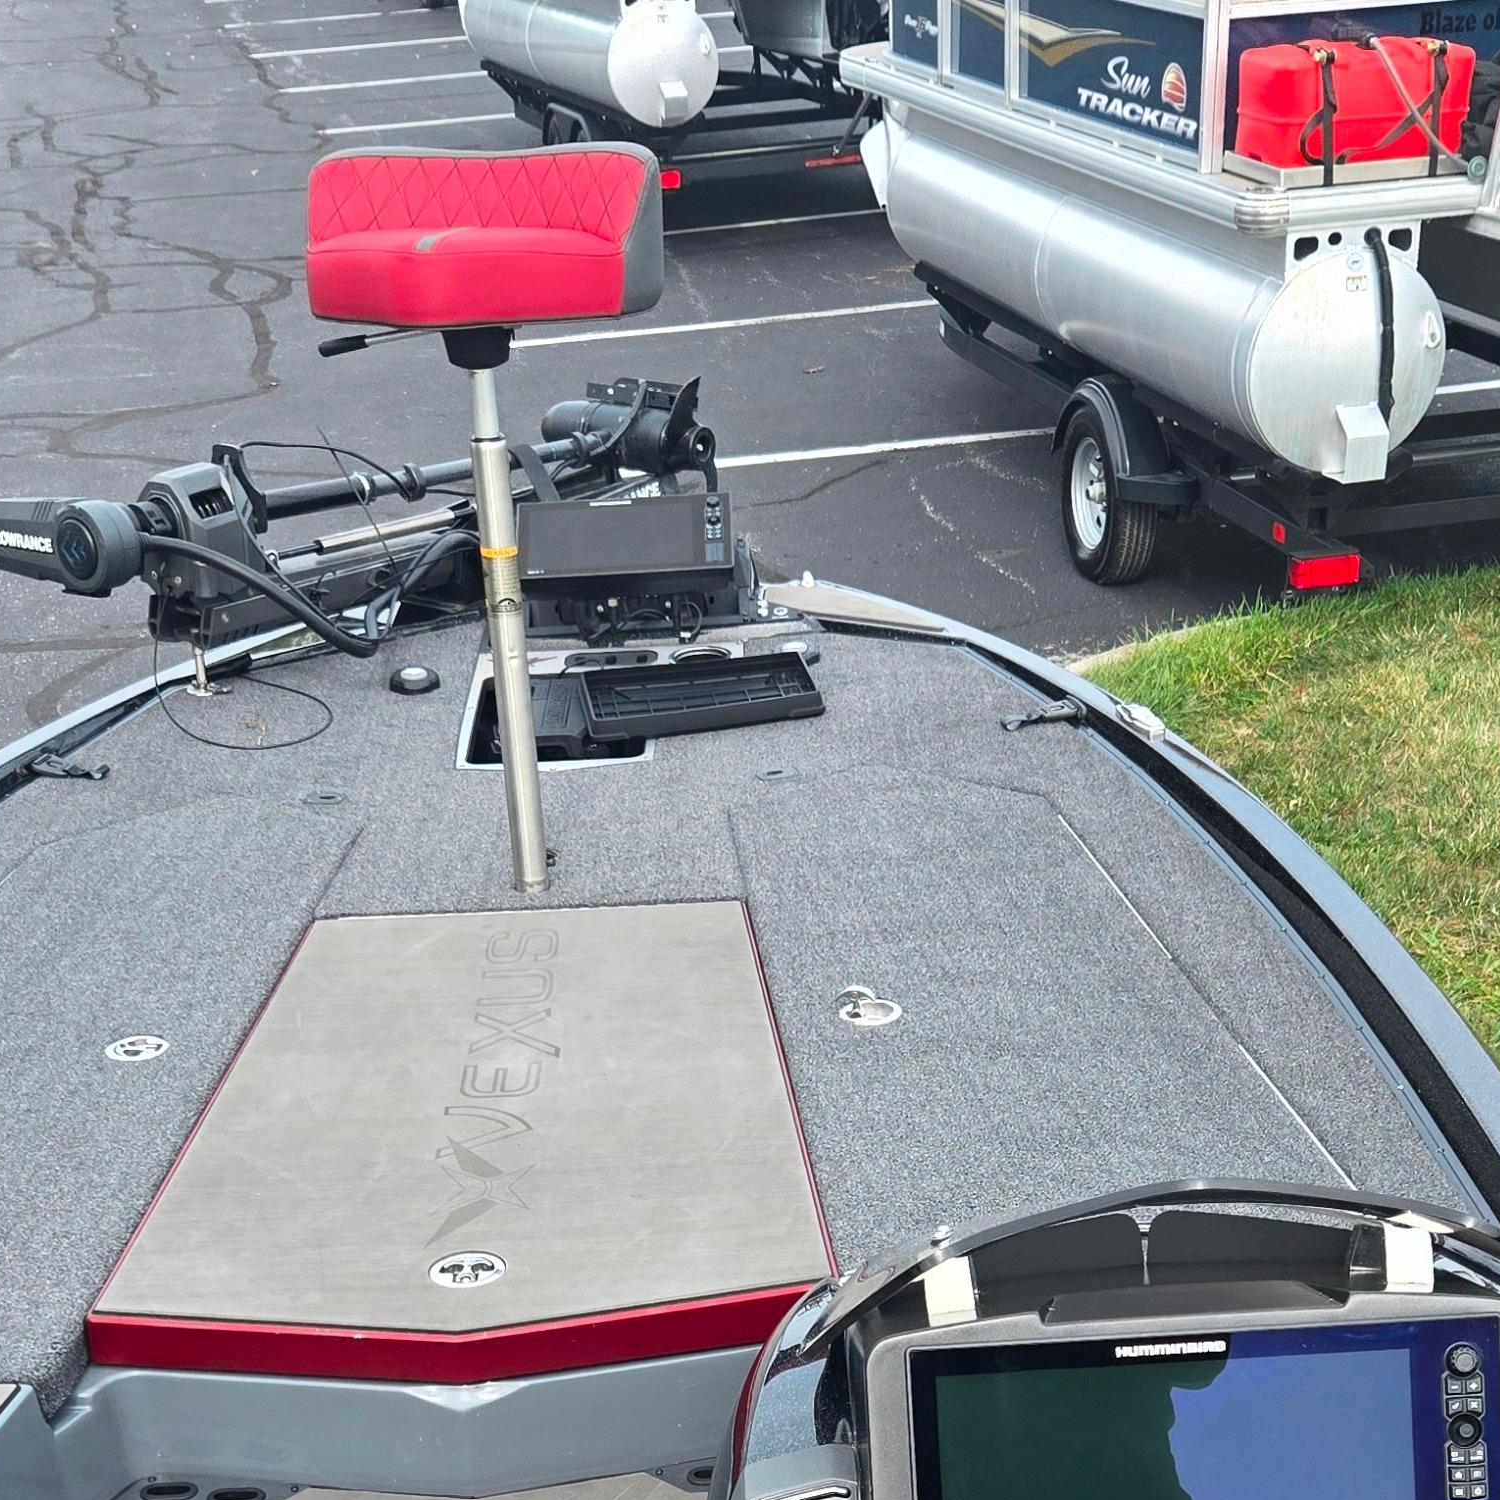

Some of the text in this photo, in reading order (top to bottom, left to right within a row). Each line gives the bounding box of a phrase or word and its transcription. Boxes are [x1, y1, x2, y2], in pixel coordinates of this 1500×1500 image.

[1420, 8, 1477, 34] Blaze
[1100, 55, 1151, 98] Sun
[1077, 87, 1198, 140] TRACKER
[434, 928, 561, 1160] VEXUS
[1114, 1340, 1227, 1359] HUMMINBIRD
